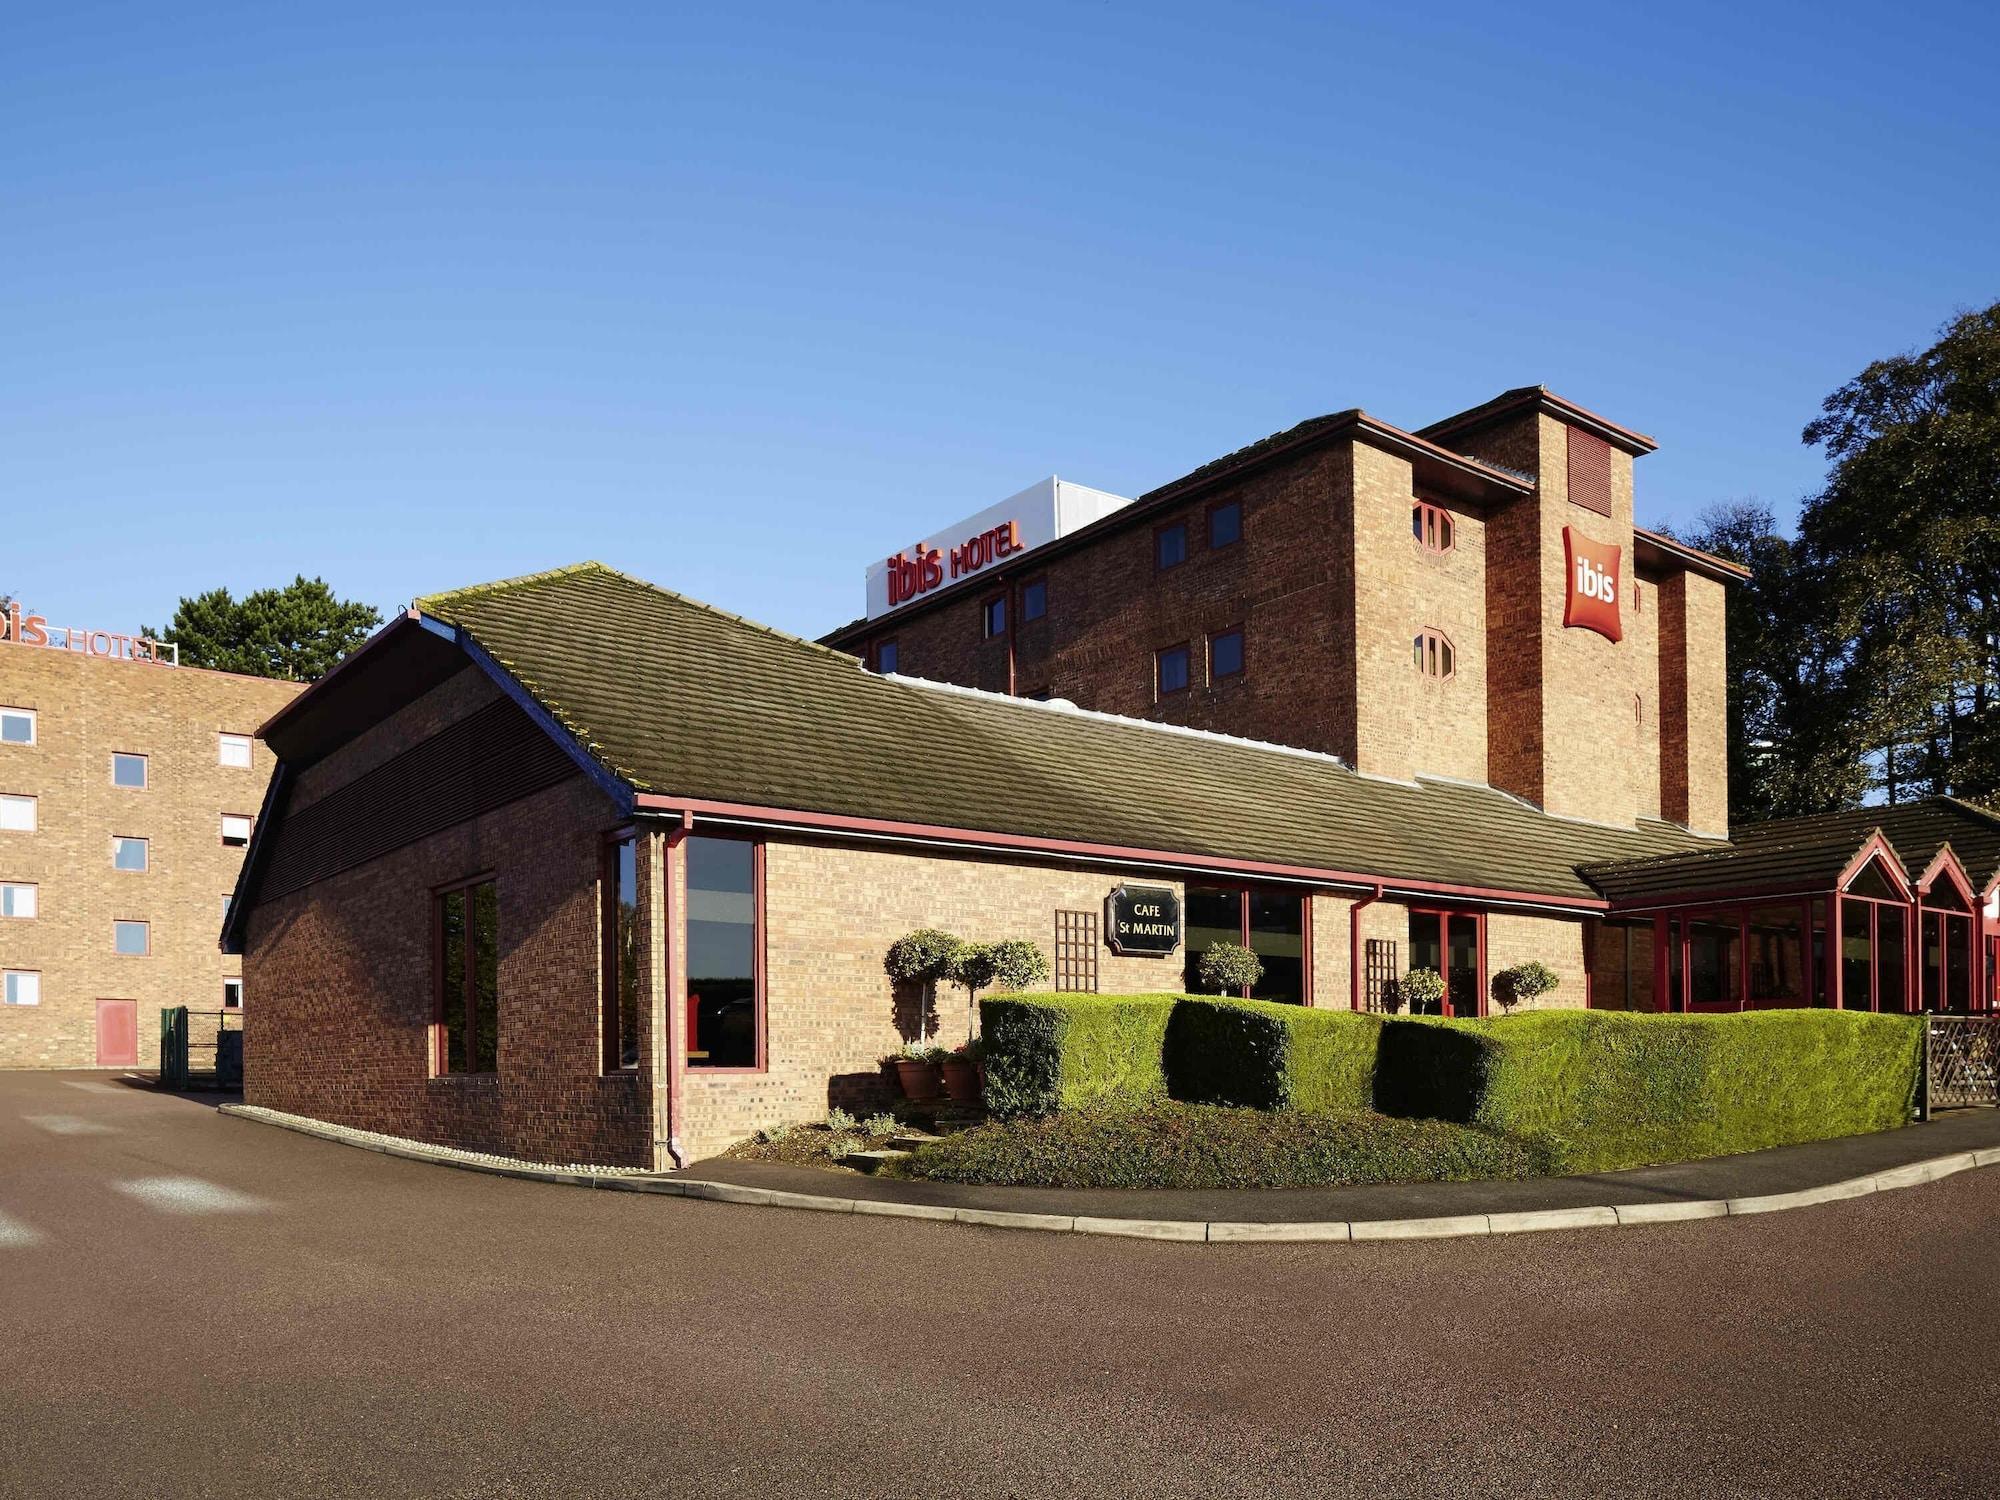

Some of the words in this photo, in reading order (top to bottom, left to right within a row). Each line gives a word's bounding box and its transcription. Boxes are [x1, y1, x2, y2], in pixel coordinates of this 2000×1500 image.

[887, 543, 943, 606] ibis
[950, 520, 1024, 579] HOTEL
[1577, 556, 1614, 604] ibis
[66, 628, 168, 666] HOTEL
[1119, 921, 1130, 934] St
[1132, 922, 1175, 937] MARTIN
[1134, 904, 1161, 917] CAFE
